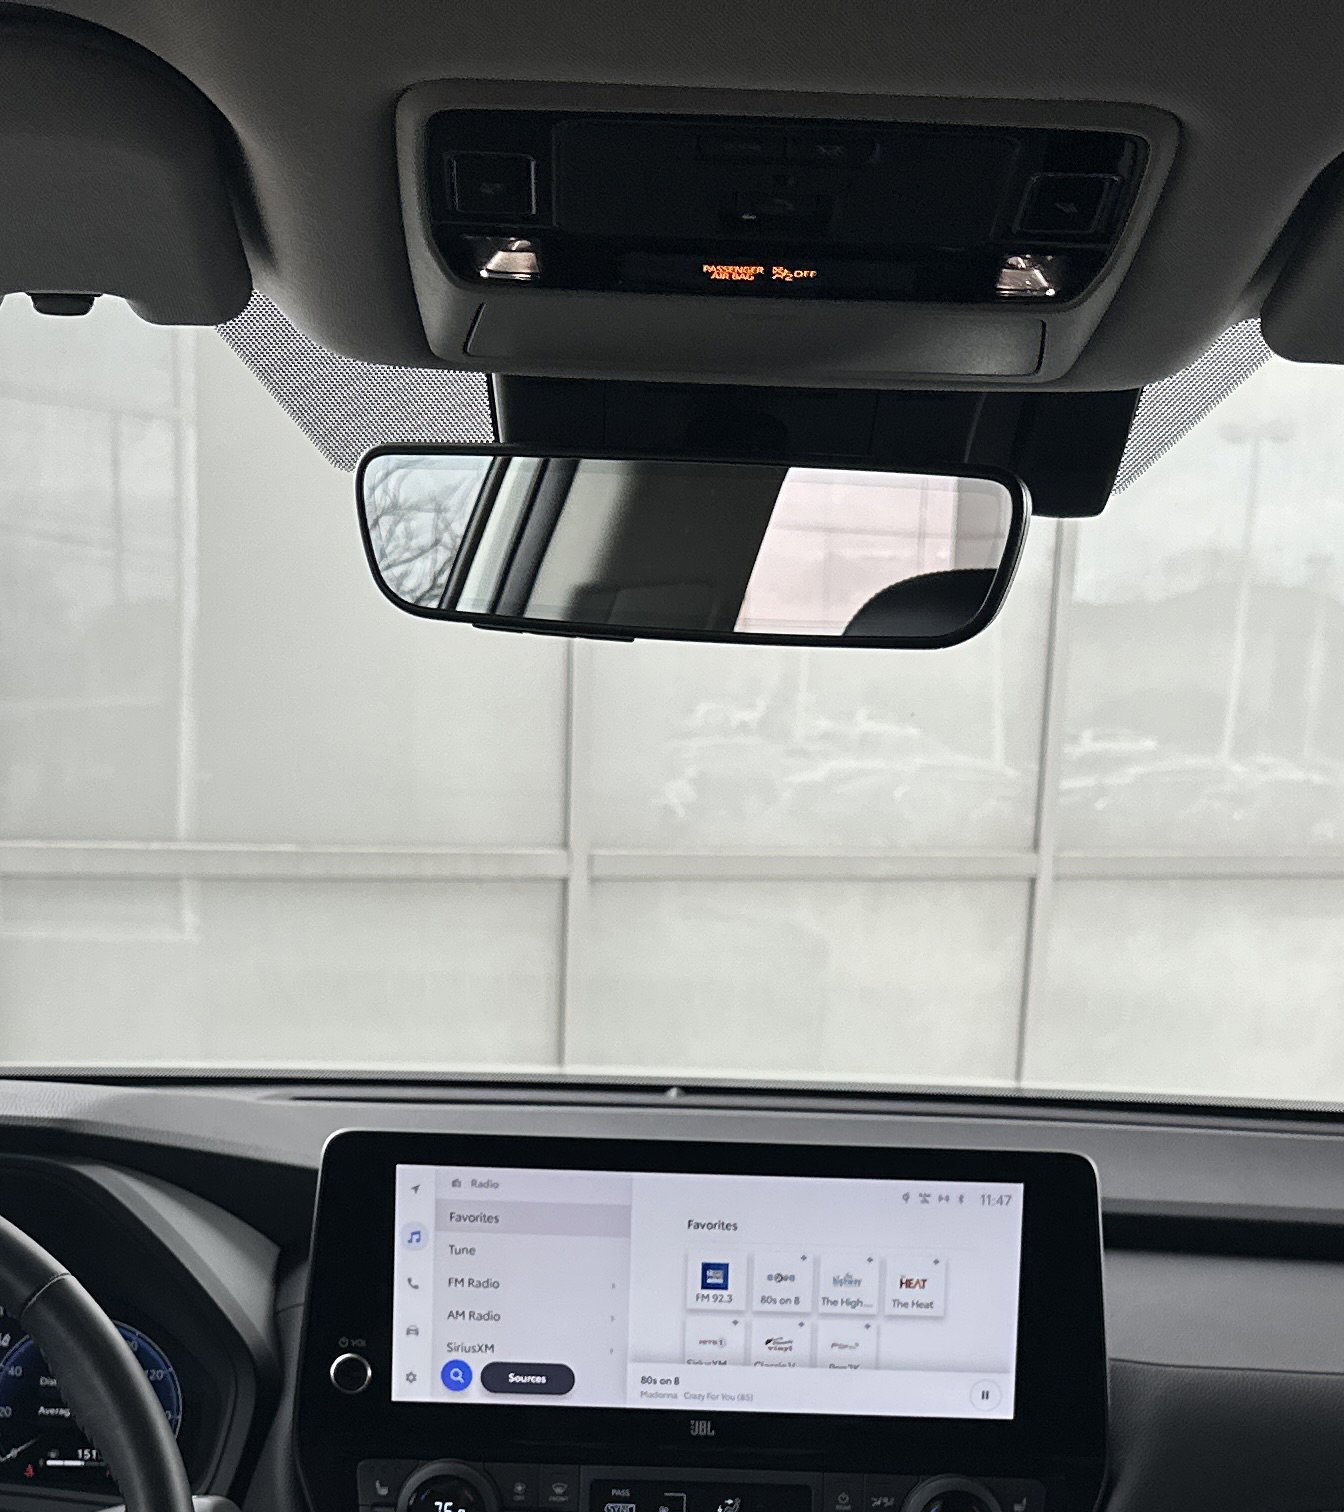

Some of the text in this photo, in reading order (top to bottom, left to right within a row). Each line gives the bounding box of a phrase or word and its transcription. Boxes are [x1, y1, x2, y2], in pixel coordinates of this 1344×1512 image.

[702, 264, 765, 275] PASSENGER
[793, 270, 817, 278] OFF
[470, 1178, 500, 1189] Radio
[980, 1194, 1012, 1206] 11:47
[449, 1211, 500, 1224] Favorites
[687, 1219, 738, 1231] Favorites
[448, 1244, 476, 1256] Tune
[448, 1277, 500, 1289] FM Radio
[900, 1278, 927, 1289] HEAT
[695, 1294, 733, 1303] FM 92.3
[760, 1295, 778, 1305] 80s
[779, 1297, 792, 1305] on
[821, 1297, 838, 1307] The
[891, 1299, 934, 1309] The Heat
[447, 1310, 501, 1322] AM Radio
[446, 1342, 495, 1354] SiriusXM
[7, 1365, 23, 1378] 40
[508, 1372, 547, 1384] Sources
[641, 1375, 658, 1385] 80s
[659, 1378, 672, 1386] on
[683, 1391, 705, 1402] Crazy
[706, 1392, 720, 1401] For
[721, 1392, 736, 1401] You
[38, 1405, 71, 1418] Averag
[690, 1420, 715, 1436] JBL
[611, 1488, 632, 1497] PASS
